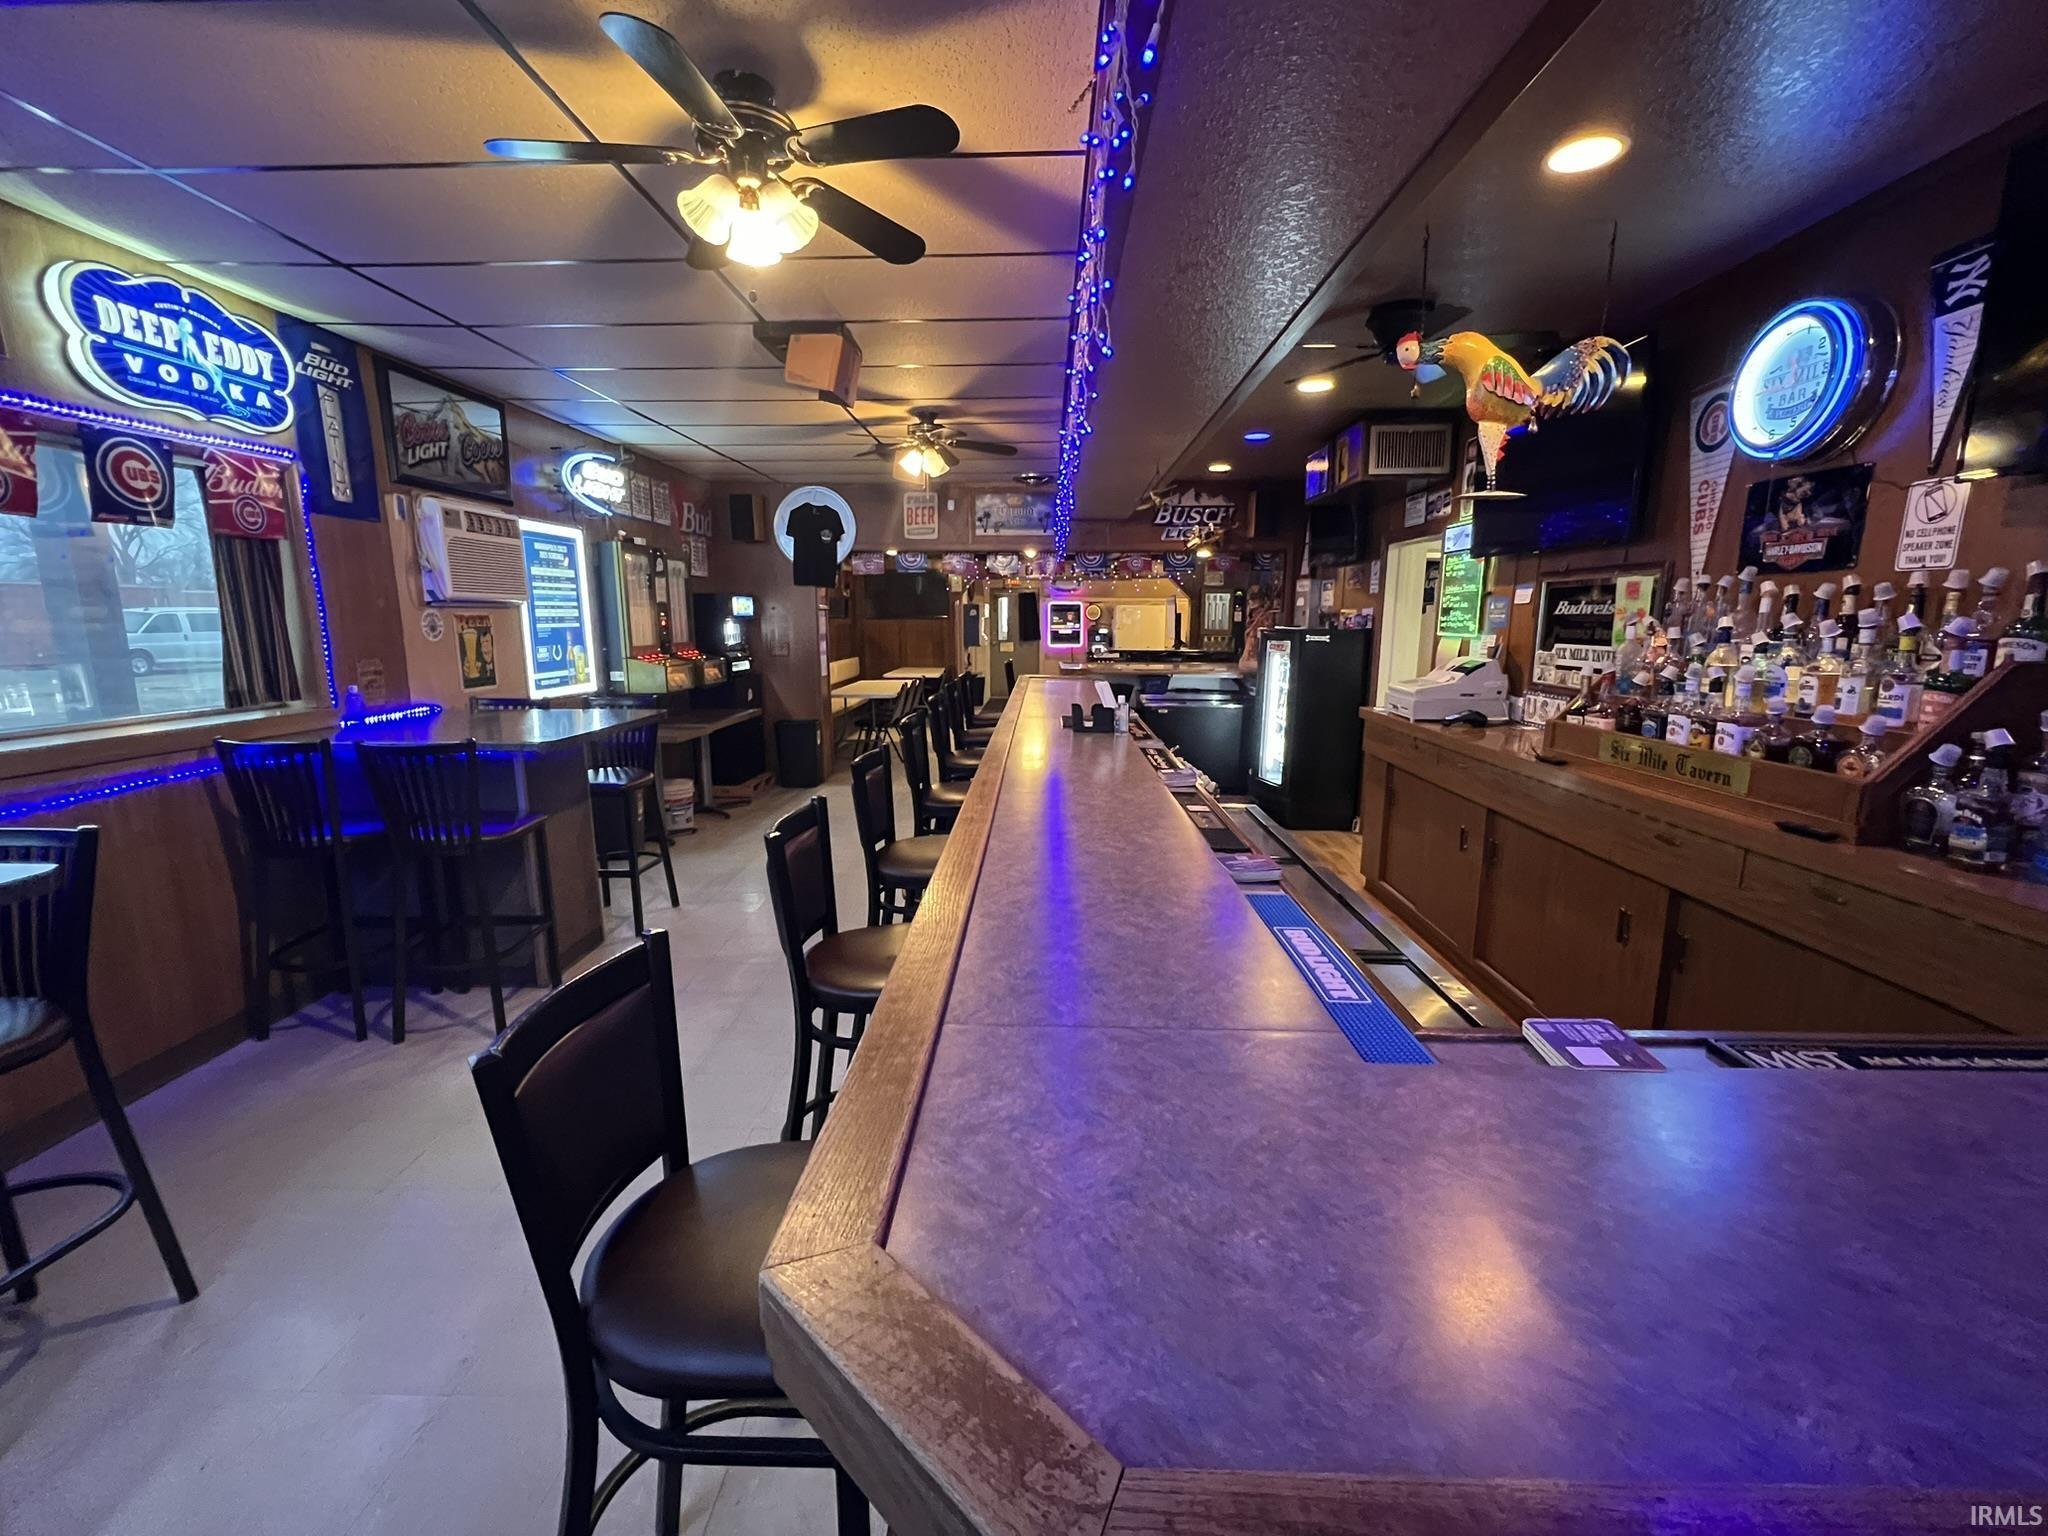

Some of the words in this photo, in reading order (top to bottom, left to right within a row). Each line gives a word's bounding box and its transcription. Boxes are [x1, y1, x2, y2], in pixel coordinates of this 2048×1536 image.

[93, 294, 181, 353] DEEP
[202, 331, 274, 382] EDDY
[296, 362, 353, 389] LIGHT
[303, 352, 349, 376] BUD
[123, 353, 272, 409] VODKA
[321, 391, 351, 498] PLATINUM
[407, 442, 448, 466] LIGHT
[680, 502, 713, 537] Bud
[906, 506, 936, 526] BEER
[1154, 502, 1235, 524] BUSCH
[1693, 480, 1710, 536] CUBS
[1917, 525, 1957, 537] CELLPHONE
[1902, 541, 1933, 552] SPEAKER
[1935, 539, 1954, 549] ZONE
[1904, 554, 1927, 564] THANK
[1553, 600, 1617, 616] Budweis
[1555, 647, 1568, 660] SIX
[1569, 647, 1590, 661] MILE
[1878, 692, 1905, 702] CARDI
[1610, 740, 1631, 763] Six
[1638, 744, 1669, 772] Mile
[1675, 753, 1732, 787] Tavern
[1283, 929, 1322, 956] BUD
[1304, 955, 1360, 1000] LIGHT
